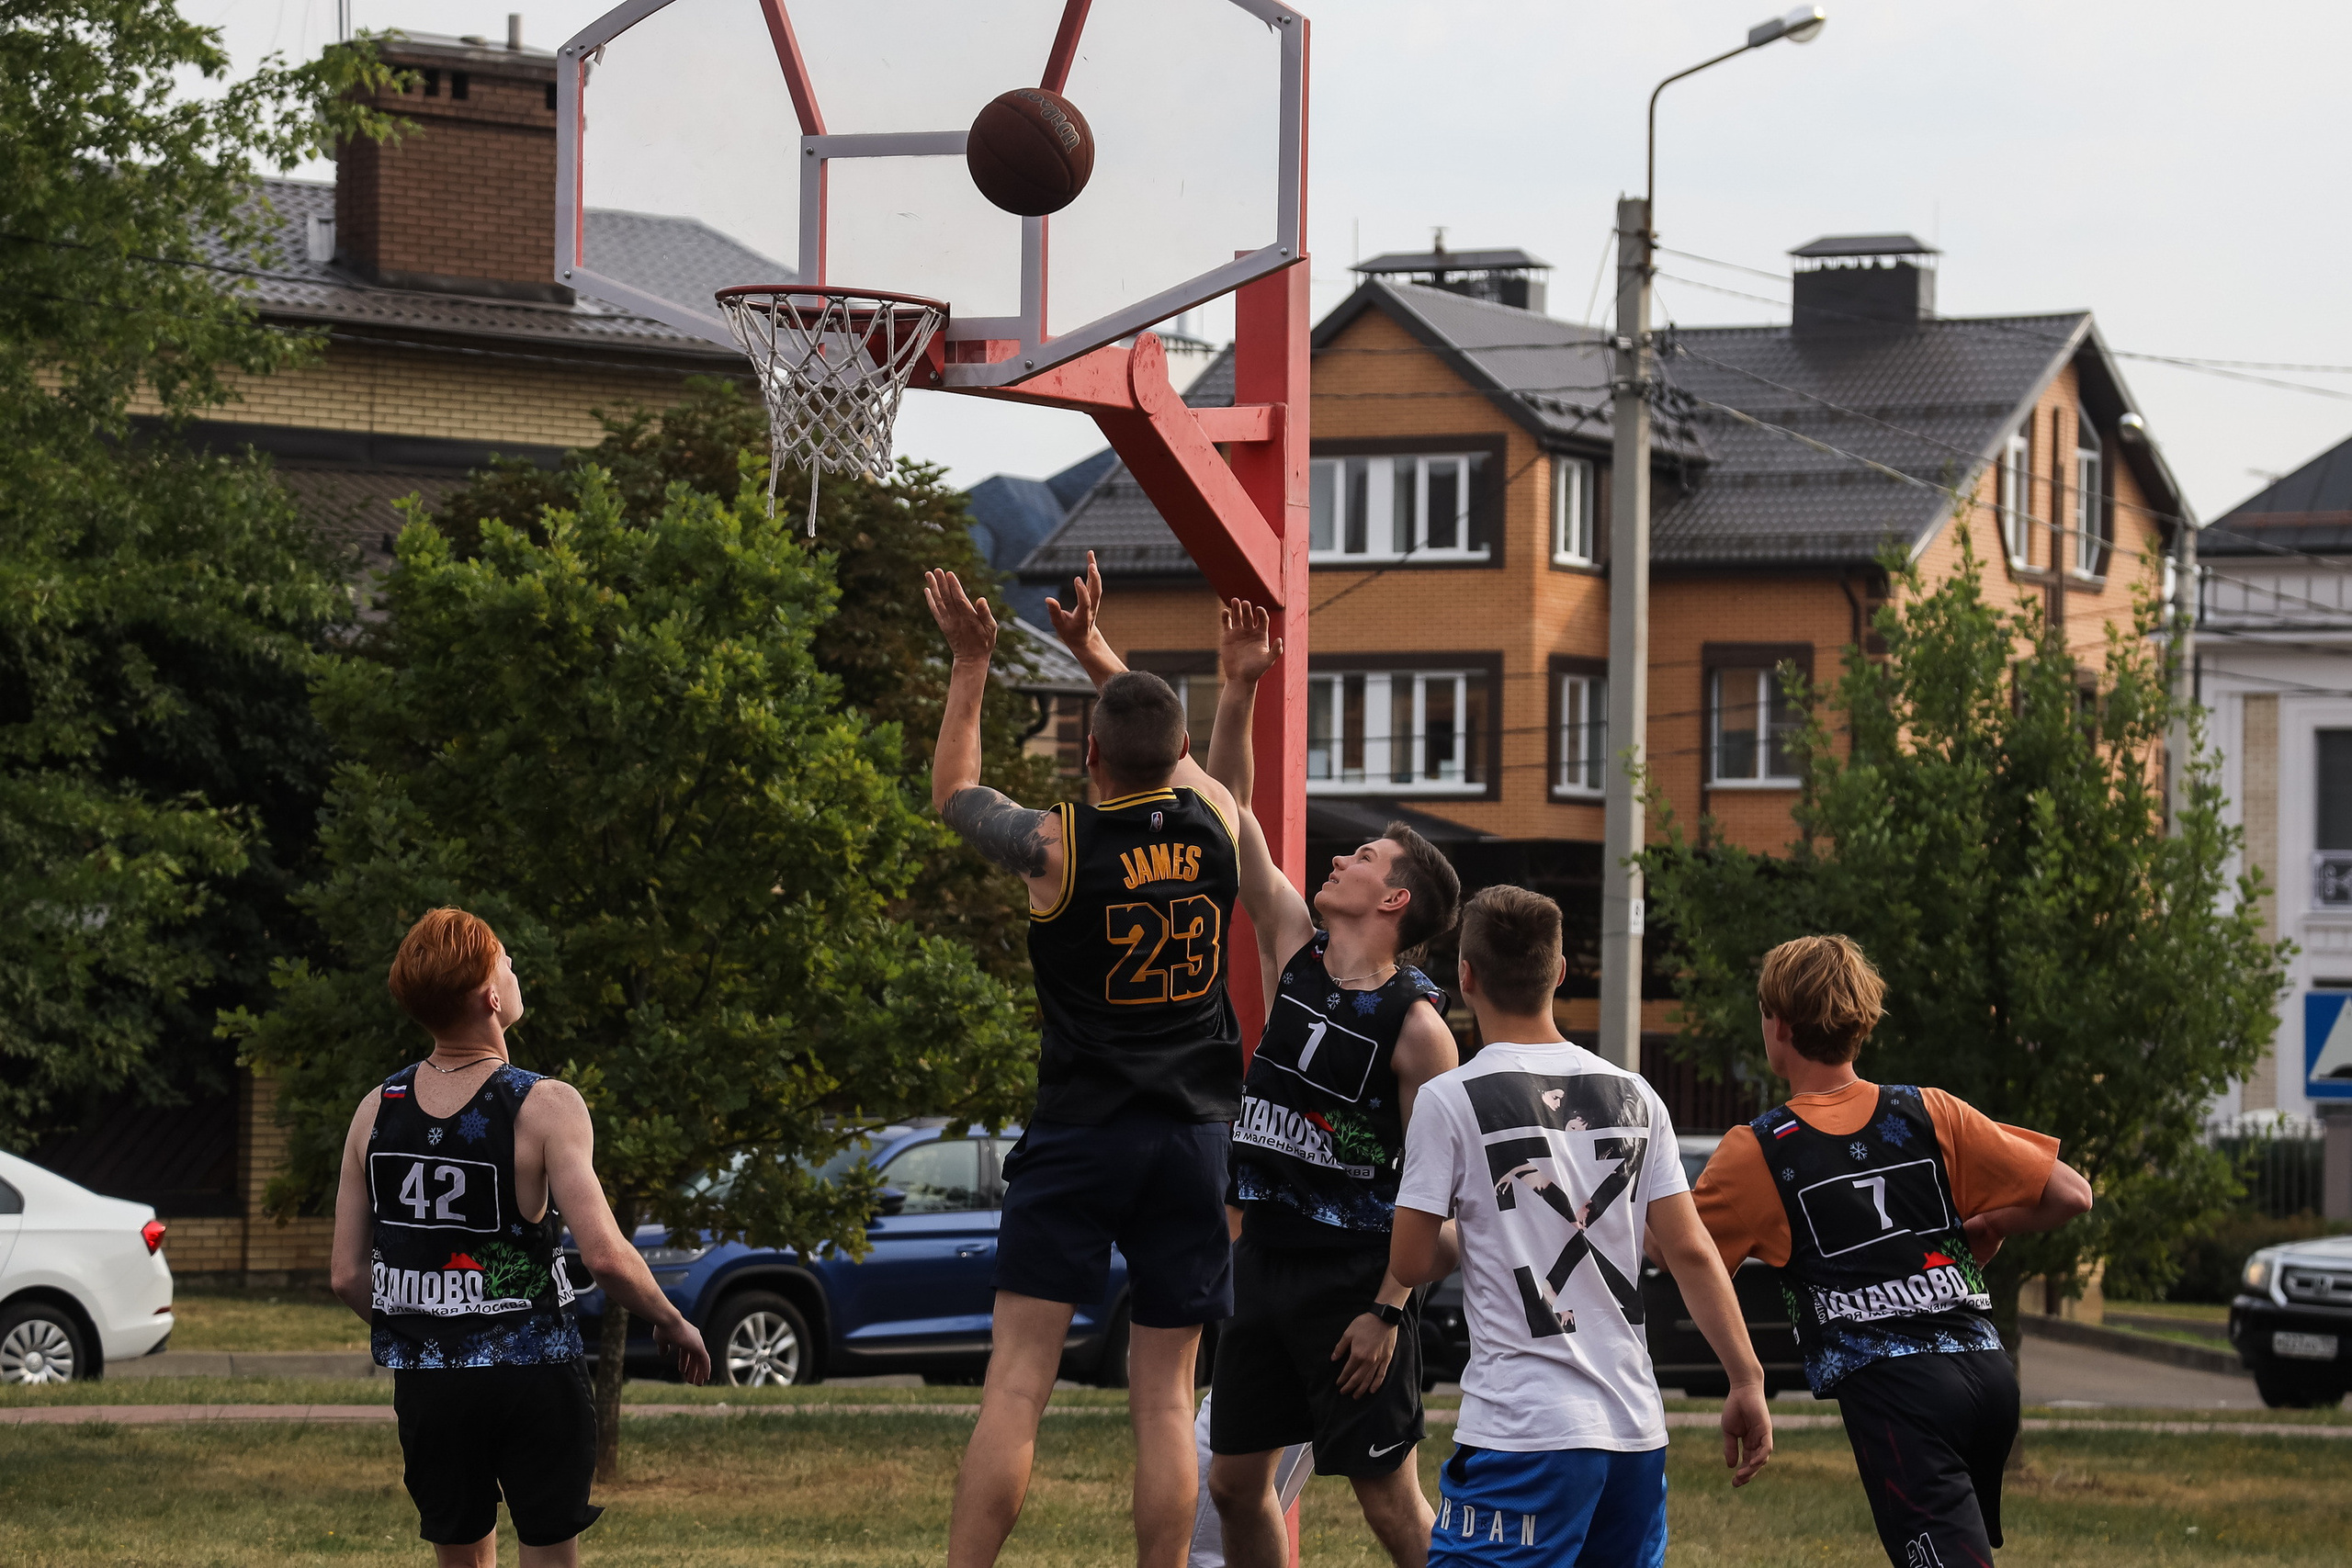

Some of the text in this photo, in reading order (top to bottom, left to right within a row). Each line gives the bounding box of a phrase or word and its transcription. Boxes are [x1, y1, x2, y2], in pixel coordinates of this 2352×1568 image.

[1119, 842, 1203, 890] JAMES
[1105, 894, 1221, 1005] 23
[1297, 1021, 1327, 1072] 1
[1239, 1095, 1334, 1155] ТАПОВО
[398, 1161, 467, 1222] 42
[1852, 1176, 1894, 1231] 7
[465, 1299, 528, 1314] Москва
[1441, 1496, 1536, 1546] RDAN
